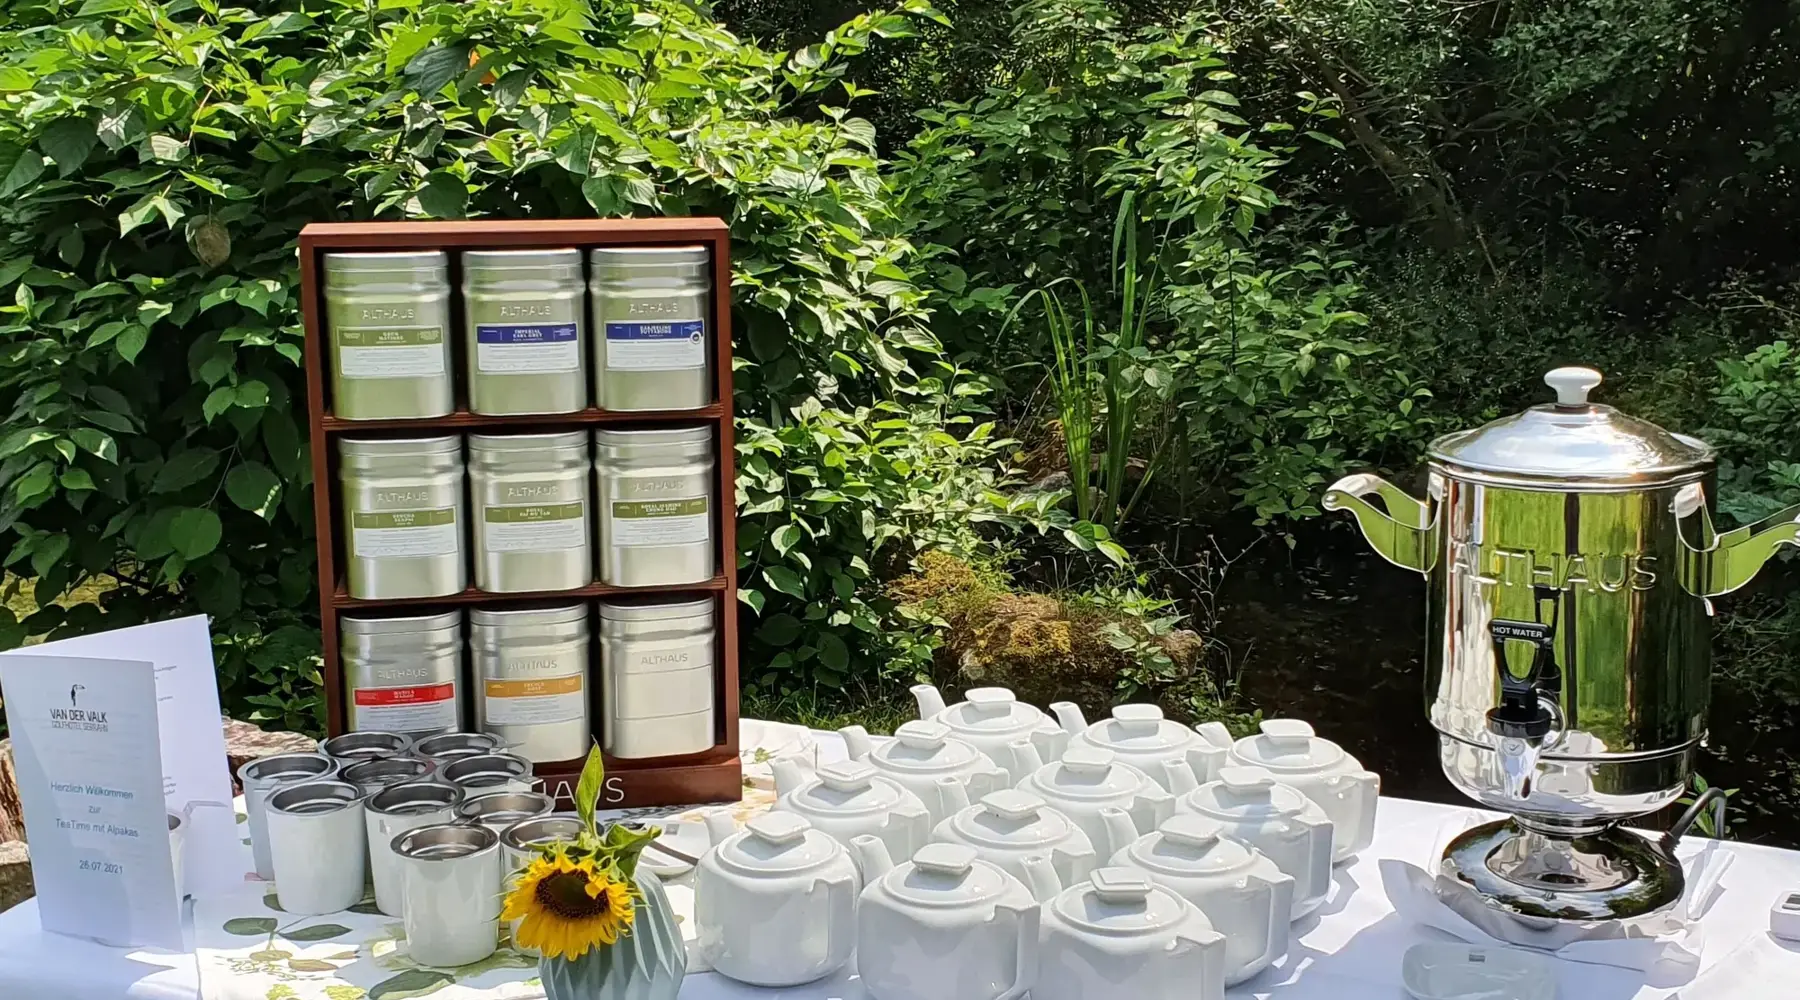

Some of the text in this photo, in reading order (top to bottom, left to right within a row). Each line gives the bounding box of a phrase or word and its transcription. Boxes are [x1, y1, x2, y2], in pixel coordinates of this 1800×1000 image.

[362, 308, 415, 320] ALTHAUS
[500, 305, 552, 317] ALTHAUS
[629, 303, 679, 314] ALTHAUS
[375, 491, 429, 502] ALTHAUS
[507, 485, 558, 497] ALTHAUS
[1450, 541, 1658, 593] ALTHAUS
[1492, 625, 1543, 638] HOT WATER
[641, 653, 688, 665] ALTHAUS
[378, 668, 428, 679] ALTHAUS
[50, 708, 108, 723] VAN DER VALK
[50, 781, 133, 800] Herzlich Willkommen
[88, 804, 102, 814] zur
[93, 821, 105, 833] mit
[106, 822, 139, 838] Alpakas
